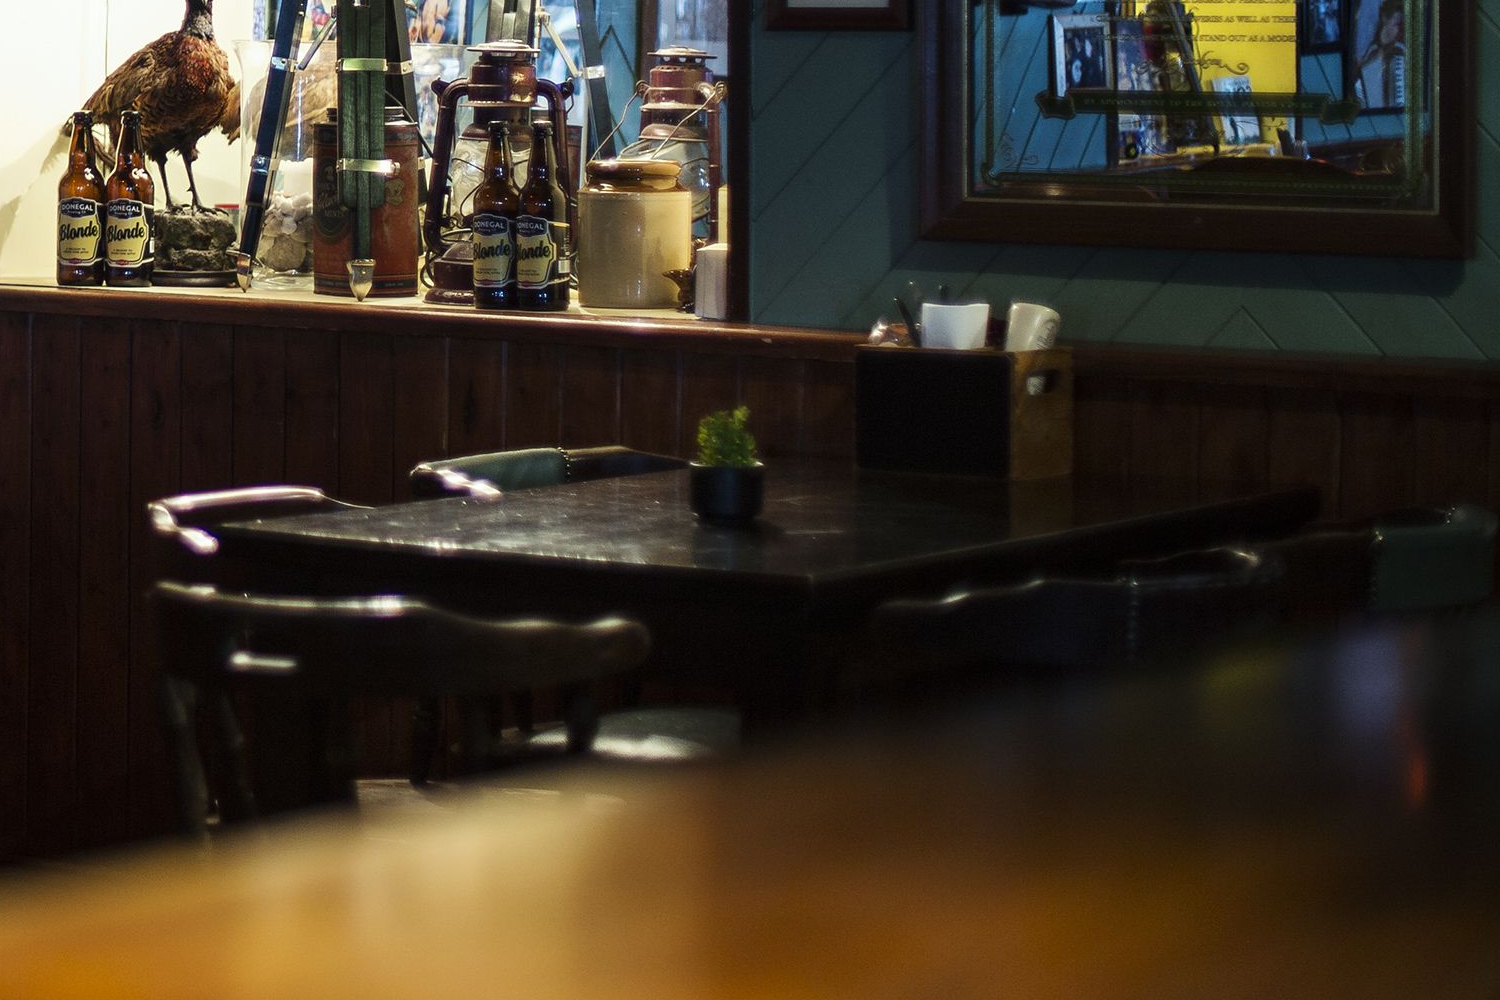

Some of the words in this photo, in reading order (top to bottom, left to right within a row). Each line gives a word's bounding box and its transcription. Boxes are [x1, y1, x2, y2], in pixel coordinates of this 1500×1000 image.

[62, 203, 93, 212] DONEGAL
[109, 204, 140, 213] DONEGAL
[60, 221, 99, 241] Blonde
[107, 222, 145, 243] Blonde
[473, 239, 510, 261] Blonde
